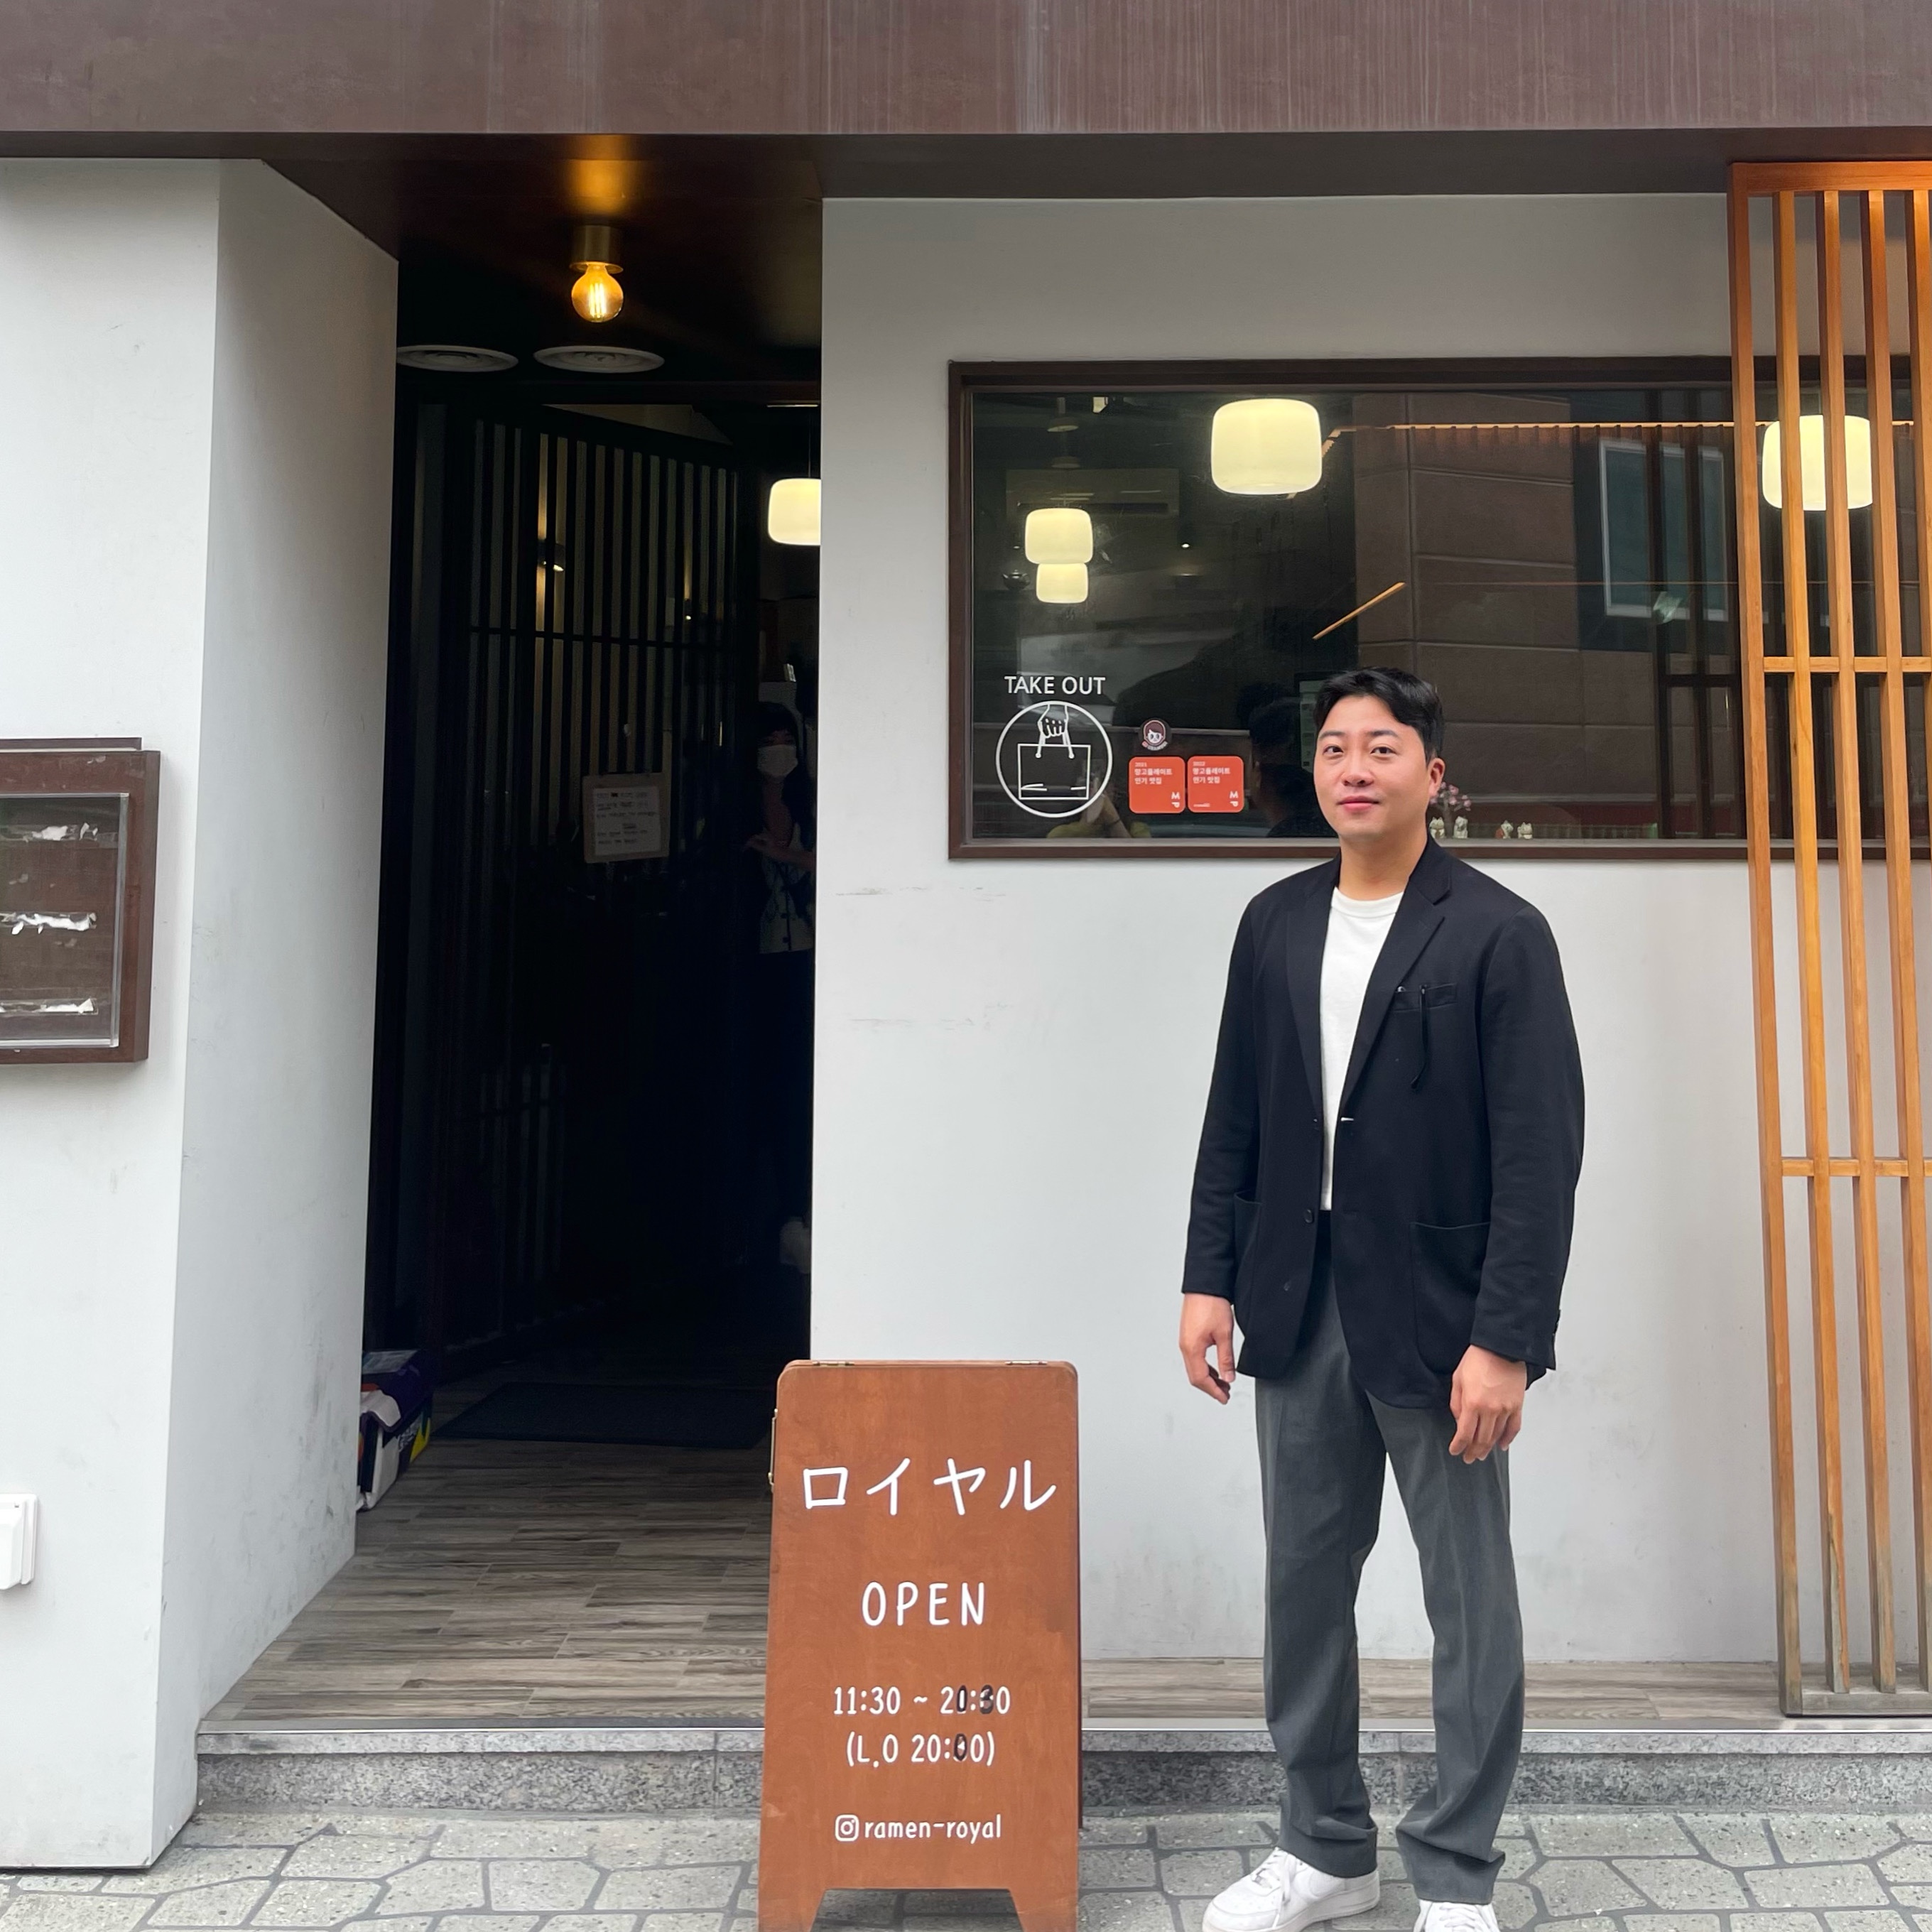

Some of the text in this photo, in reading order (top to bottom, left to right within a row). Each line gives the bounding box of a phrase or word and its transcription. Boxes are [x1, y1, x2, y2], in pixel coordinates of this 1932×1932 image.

[1003, 675, 1106, 695] TAKE OUT
[802, 1457, 1057, 1516] ロイヤル
[861, 1580, 985, 1627] OPEN
[833, 1686, 901, 1715] 11:30
[864, 1813, 1002, 1845] ramen-royal
